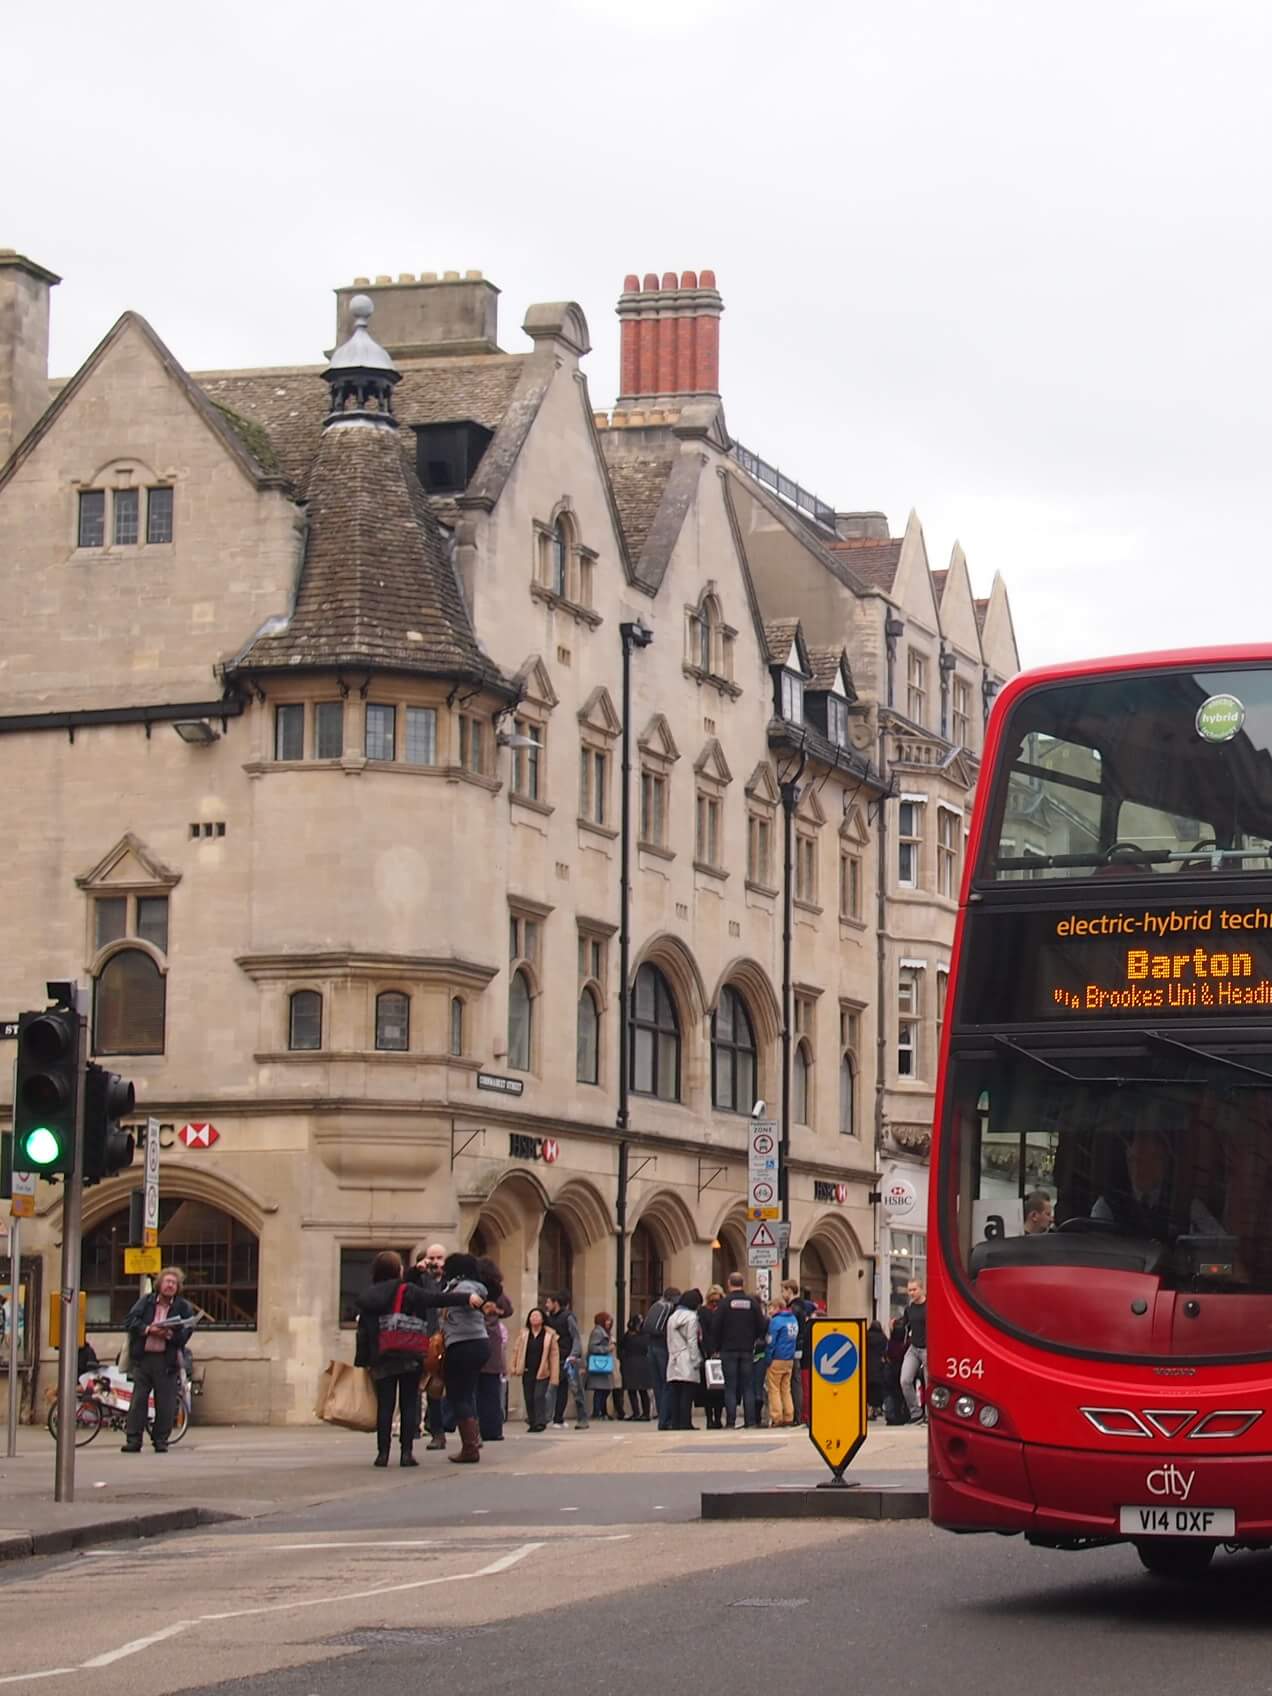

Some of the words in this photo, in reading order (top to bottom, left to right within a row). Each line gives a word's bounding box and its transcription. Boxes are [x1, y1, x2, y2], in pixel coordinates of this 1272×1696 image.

[1202, 711, 1239, 724] hybrid
[1056, 909, 1212, 937] electric-hybrid
[1127, 948, 1252, 980] Barton
[1086, 984, 1165, 1008] Brookes
[1168, 982, 1197, 1007] Uni
[1201, 982, 1214, 1005] &
[884, 1195, 912, 1207] HSBC
[945, 1358, 985, 1379] 364
[1146, 1464, 1196, 1500] city
[1140, 1510, 1170, 1531] V14
[1176, 1511, 1215, 1532] OXF
